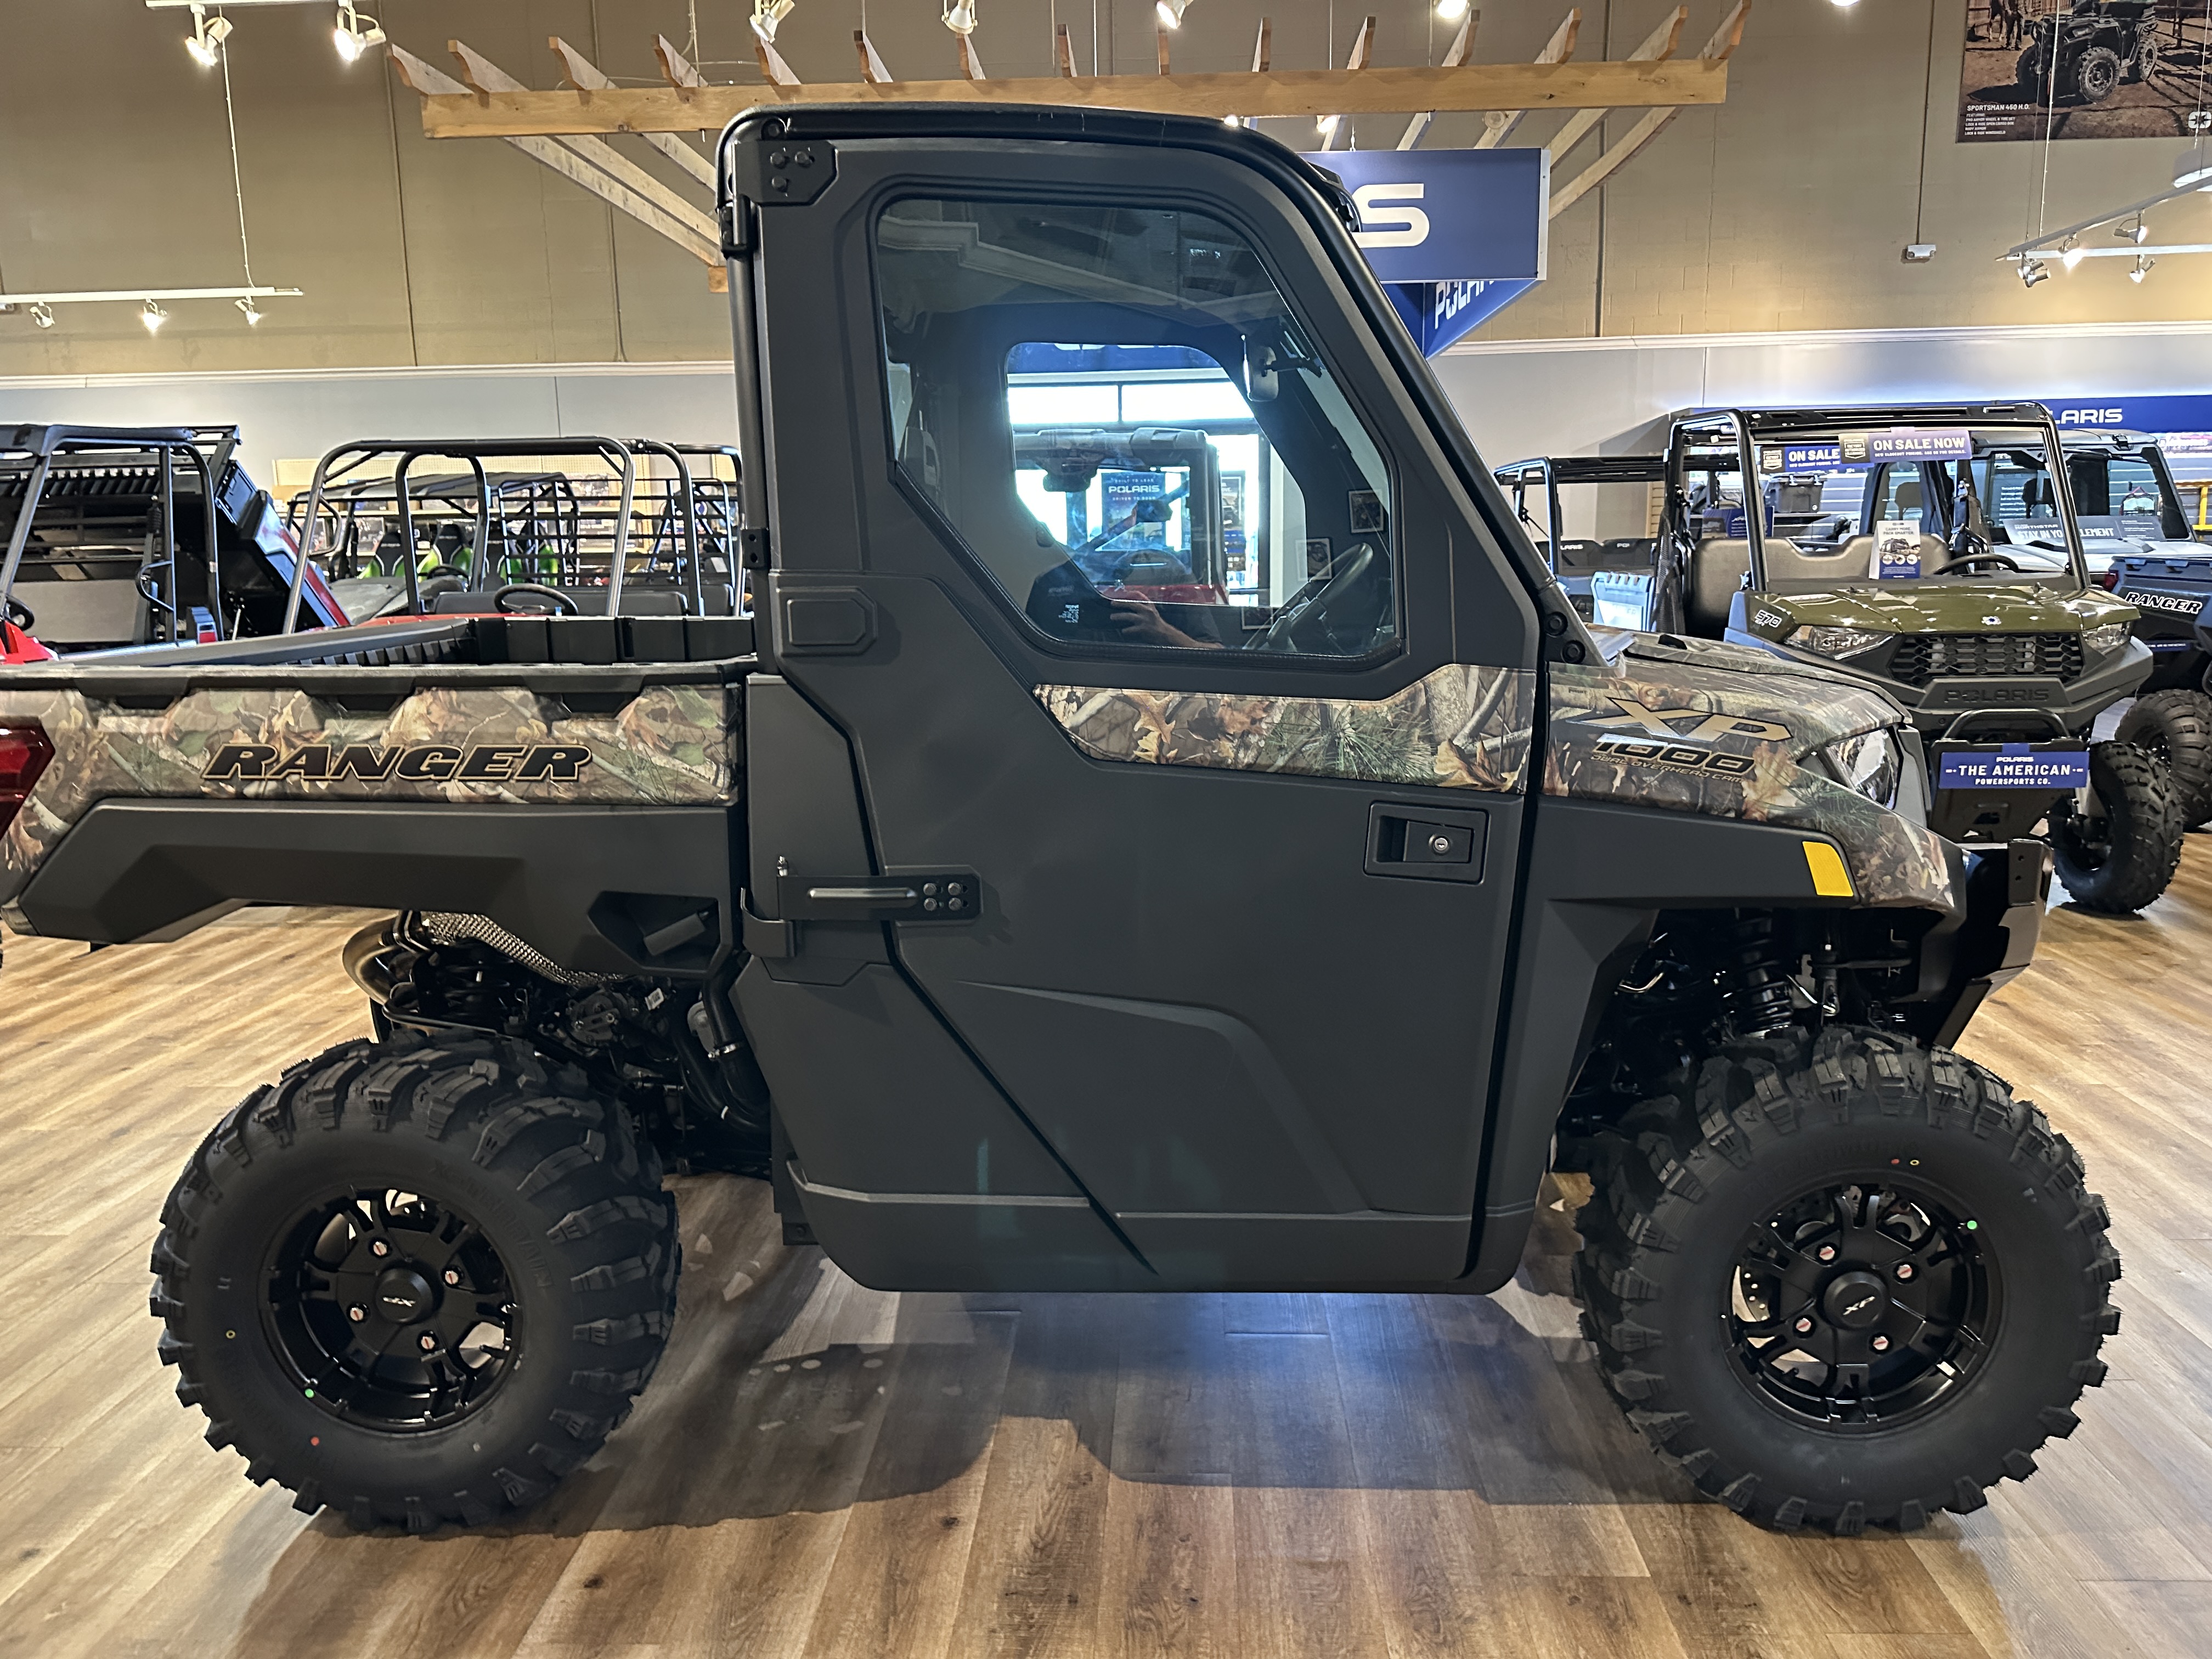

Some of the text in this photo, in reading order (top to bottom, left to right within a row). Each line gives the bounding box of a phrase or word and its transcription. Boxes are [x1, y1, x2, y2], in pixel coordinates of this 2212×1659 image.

[1874, 437, 1965, 451] ON SALE NOW
[1788, 451, 1805, 462] ON
[1808, 448, 1840, 461] SALE
[1108, 485, 1160, 493] POLARIS
[2018, 530, 2039, 539] STAY
[2040, 530, 2051, 538] IN
[2052, 529, 2063, 538] YO
[2080, 528, 2114, 537] LEMENT
[2125, 591, 2203, 614] RANGER
[1755, 609, 1782, 628] 570
[1944, 689, 2050, 703] POLARIS
[1565, 696, 1794, 743] XP
[200, 743, 592, 780] RANGER
[1592, 733, 1755, 776] 1000
[1590, 754, 1745, 783] DUAL OVERHEAD CAM
[1959, 765, 2070, 776] THE AMERICAN
[1843, 1296, 1875, 1316] XP
